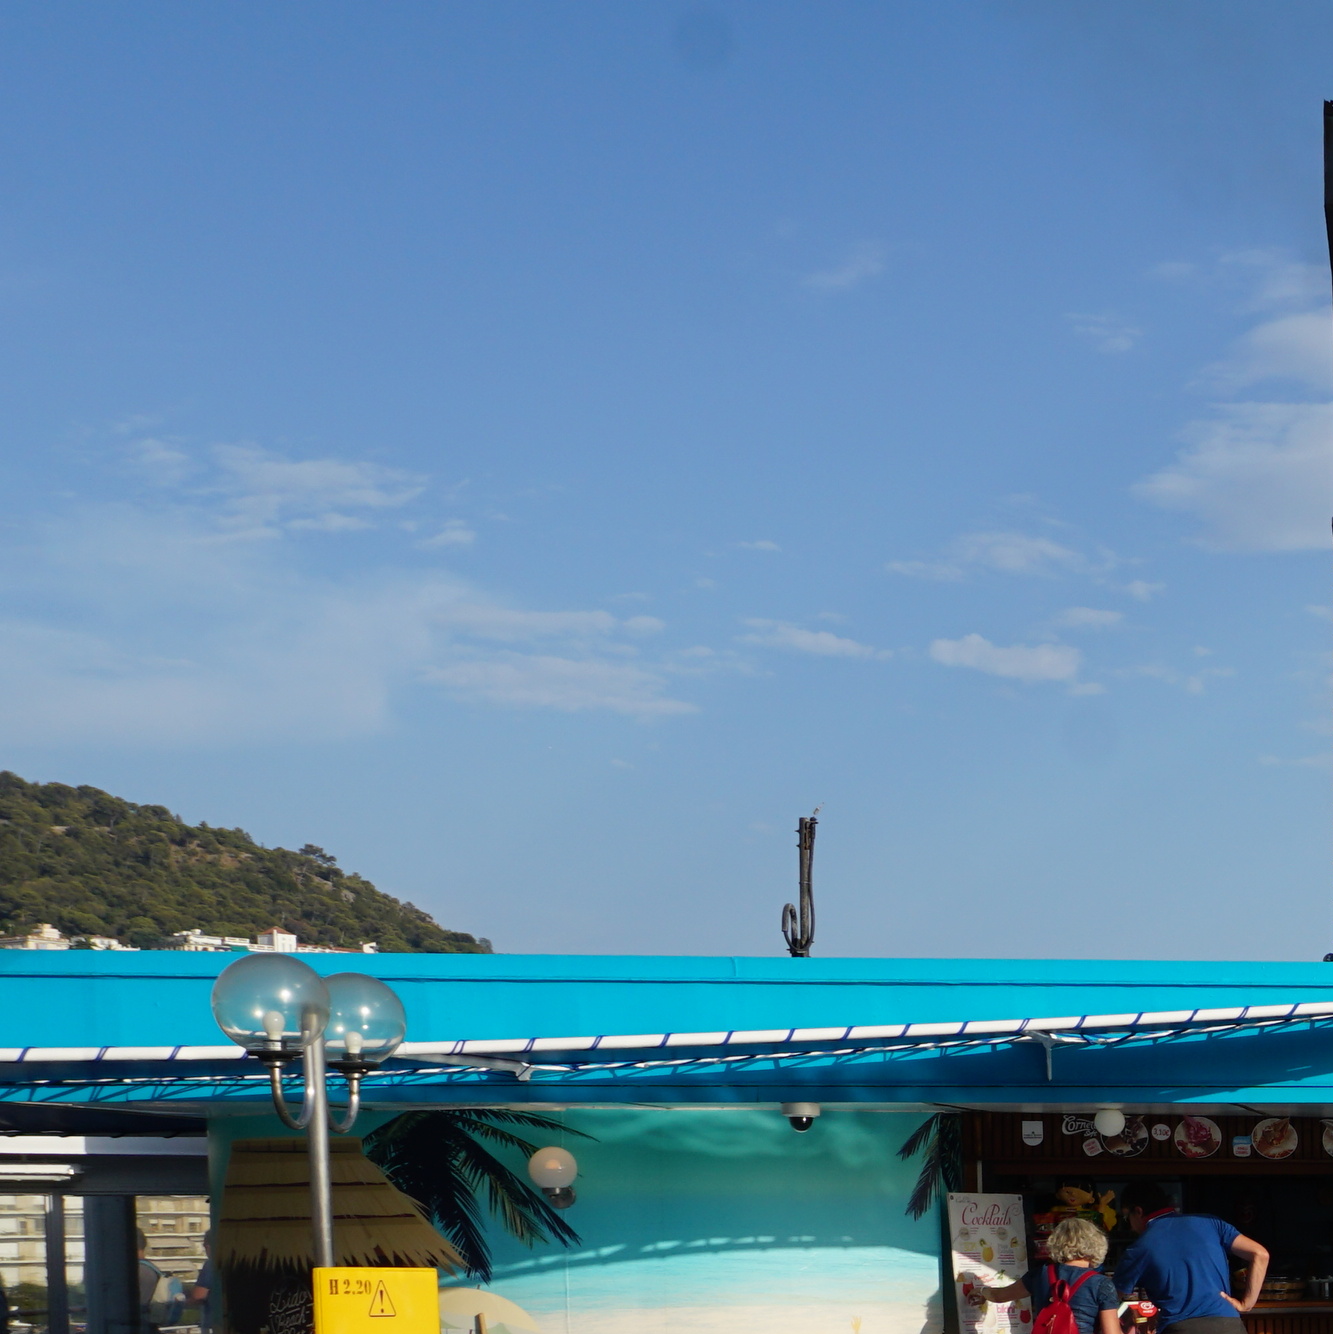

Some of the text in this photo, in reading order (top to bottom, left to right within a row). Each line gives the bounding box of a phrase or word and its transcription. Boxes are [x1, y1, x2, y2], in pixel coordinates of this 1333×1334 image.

[1062, 1115, 1096, 1134] Corne
[962, 1202, 1021, 1226] Cocktails
[329, 1279, 372, 1295] H 2.20
[270, 1284, 308, 1313] Lido
